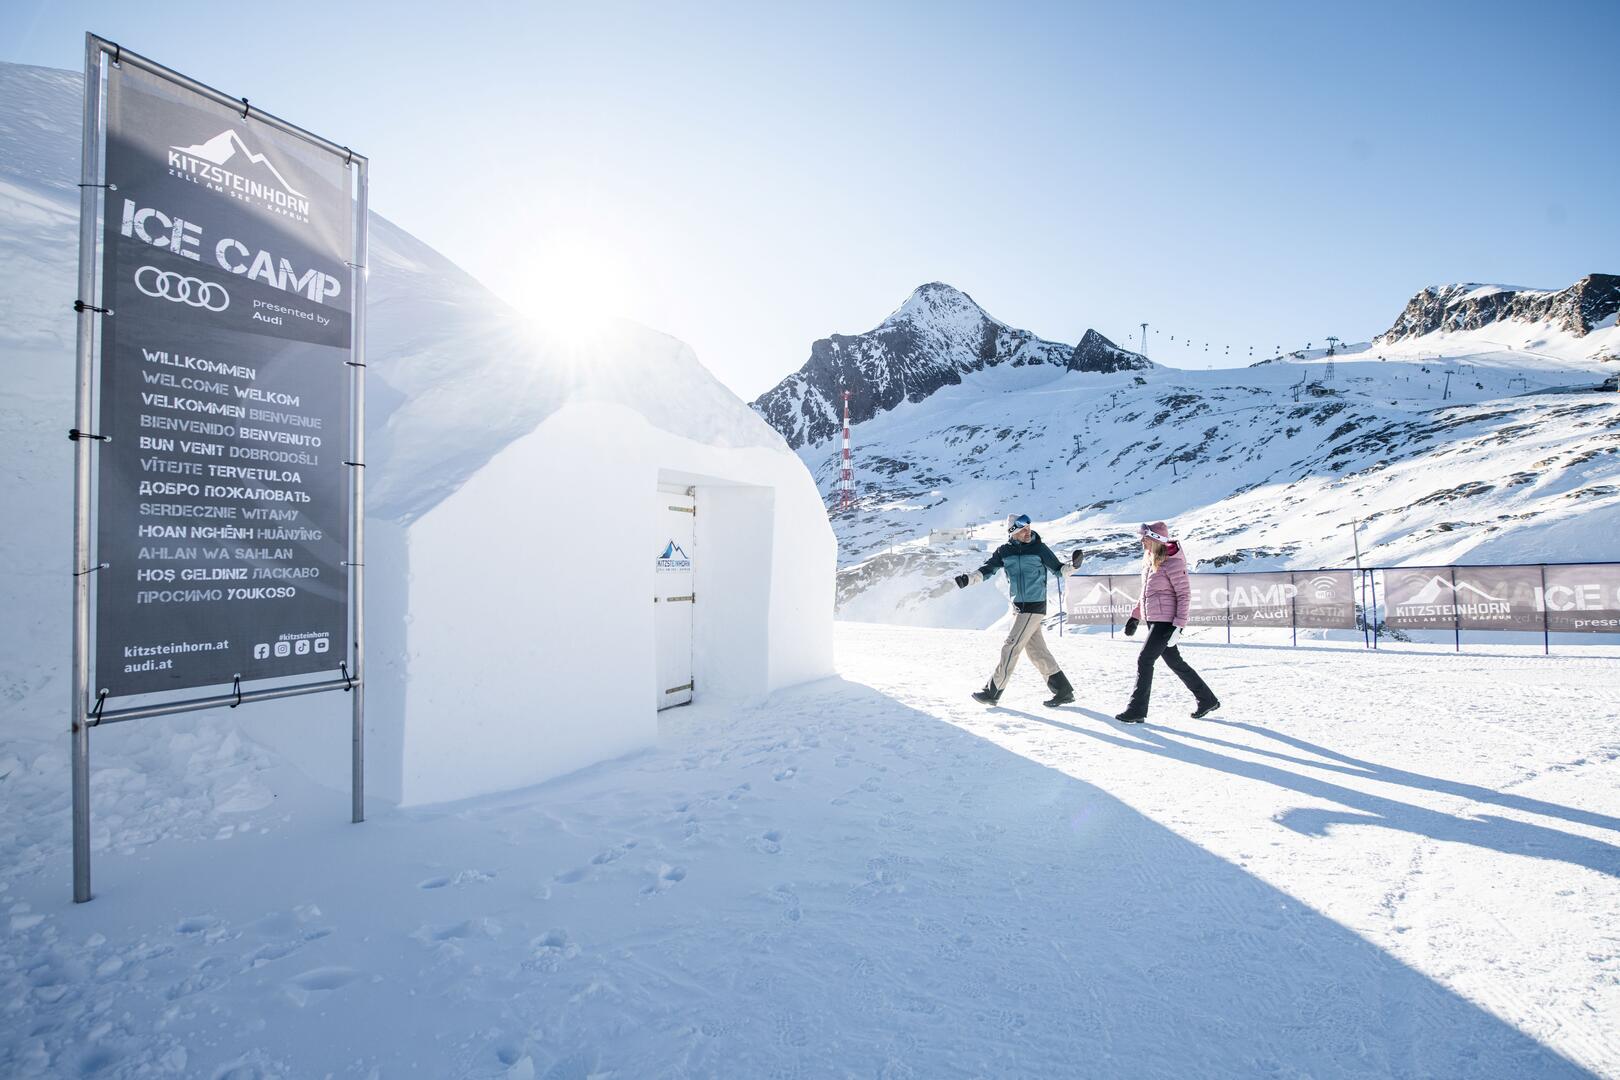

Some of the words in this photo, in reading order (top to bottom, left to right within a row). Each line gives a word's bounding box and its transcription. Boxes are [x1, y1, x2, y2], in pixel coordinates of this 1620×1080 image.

[168, 151, 309, 216] KITZSTEINHORN
[169, 169, 199, 184] ZELL
[206, 182, 223, 193] AM
[231, 190, 250, 203] SEE
[267, 204, 309, 224] KAPRUN
[120, 198, 203, 261] ICE
[215, 238, 341, 304] CAMP
[253, 299, 314, 321] presented
[316, 314, 330, 326] by
[253, 311, 283, 325] Audi
[142, 348, 256, 380] WILLKOMMEN
[142, 370, 229, 396] WELCOME
[234, 385, 300, 407] WELKOM
[141, 392, 246, 418] VELKOMMEN
[250, 408, 322, 429] BIENVENUE
[140, 414, 235, 437] BIENVENIDO
[239, 427, 322, 447] BENVENUTO
[140, 436, 174, 451] BUN
[179, 440, 225, 456] VENIT
[208, 464, 302, 484] TERVETULOA
[139, 480, 199, 496] ДОБРО
[205, 485, 311, 503] ПОЖАЛОВАТЬ
[139, 503, 237, 519] SERDECZNIE
[241, 508, 299, 521] WITAMY
[138, 525, 187, 538] HOAN
[137, 547, 197, 560] AHLAN
[202, 547, 230, 560] WA
[235, 548, 293, 560] SAHLAN
[180, 568, 248, 581] GELDINIZ
[252, 567, 319, 579] ЛАСКАВО
[136, 589, 222, 604] ПРОСИМО
[227, 587, 296, 600] YOUKOSO
[1210, 583, 1298, 608] CAMP
[1534, 584, 1604, 612] ICE
[1073, 604, 1136, 614] KITZSTEINHO
[1253, 609, 1289, 619] Audi
[1396, 602, 1511, 617] KITZSTEINHORN
[279, 631, 329, 641] #kitzsteinhorn
[124, 640, 229, 658] kitzsteinhorn.at
[124, 659, 173, 673] audi.at
